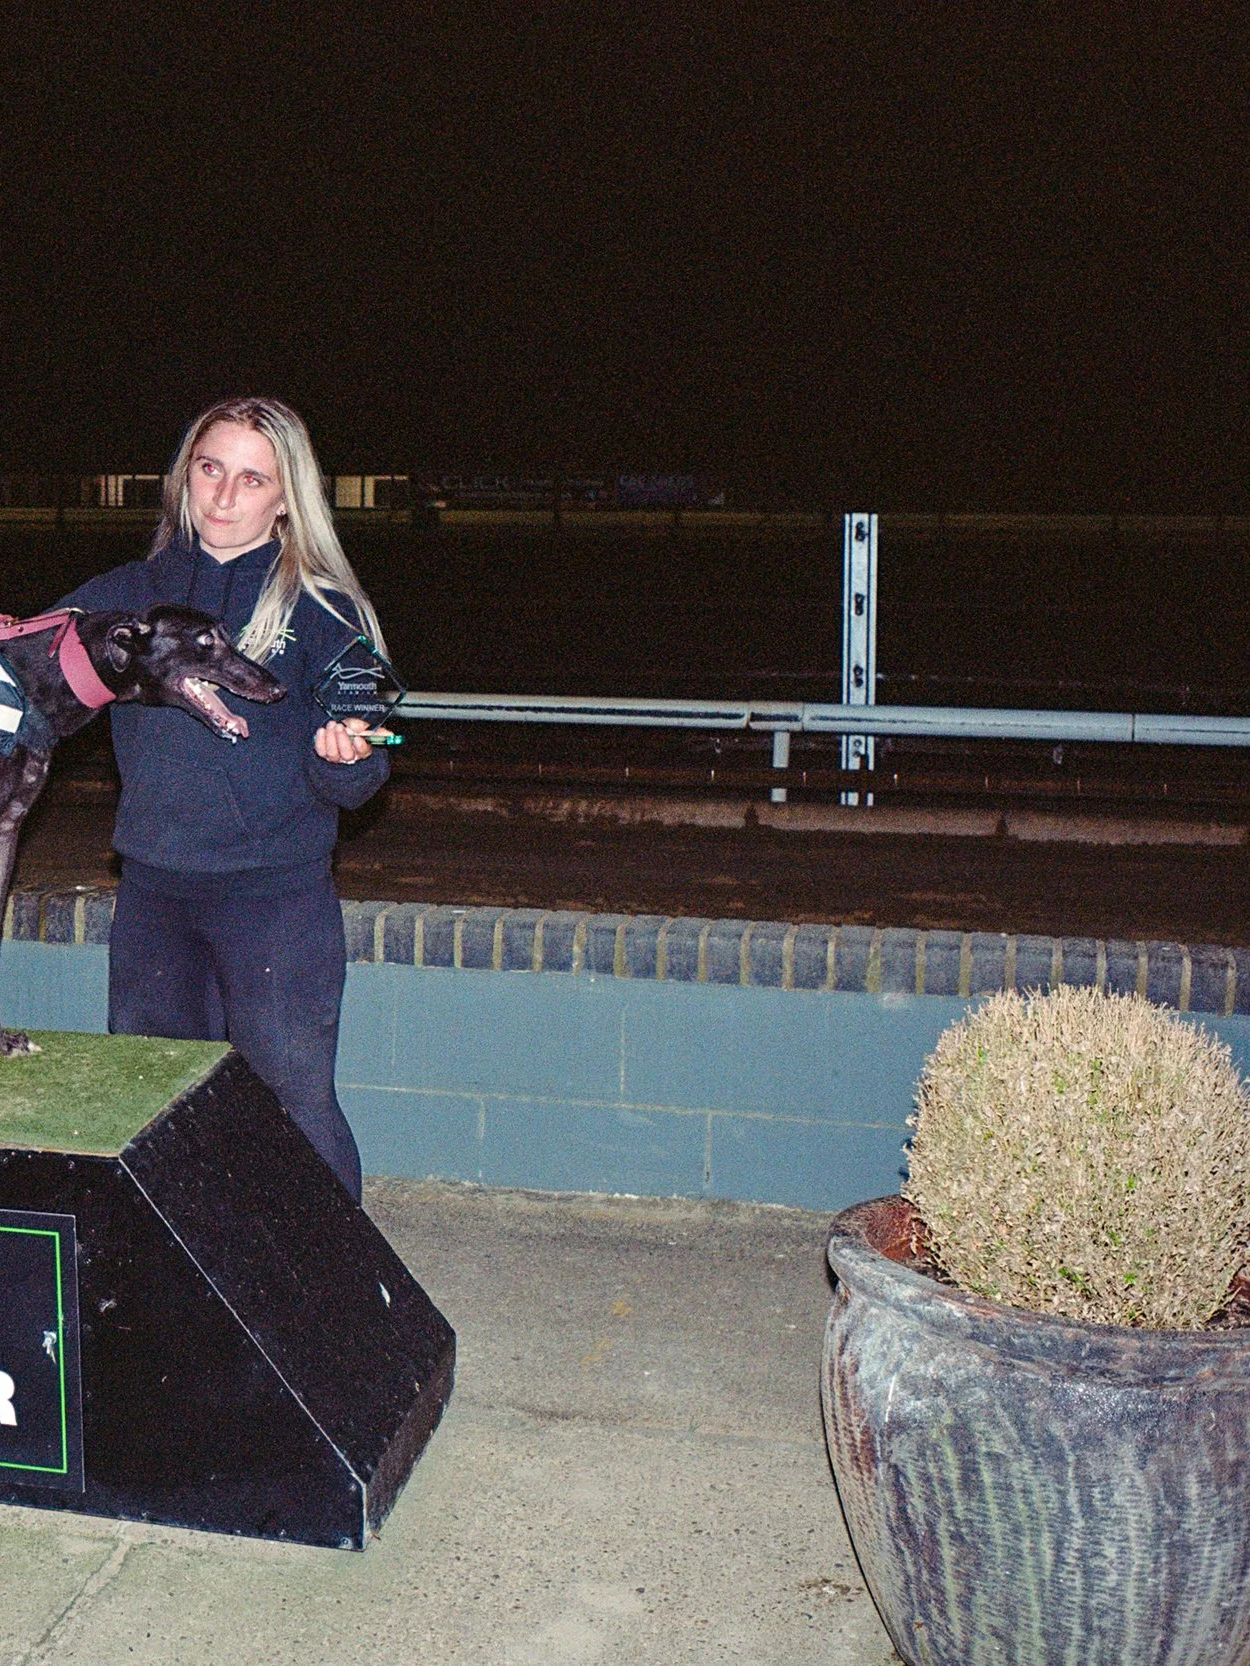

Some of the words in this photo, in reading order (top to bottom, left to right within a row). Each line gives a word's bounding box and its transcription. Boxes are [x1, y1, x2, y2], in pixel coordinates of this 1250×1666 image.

[337, 681, 378, 691] Yarmouth
[331, 703, 353, 712] RACE
[354, 703, 386, 713] WINNER
